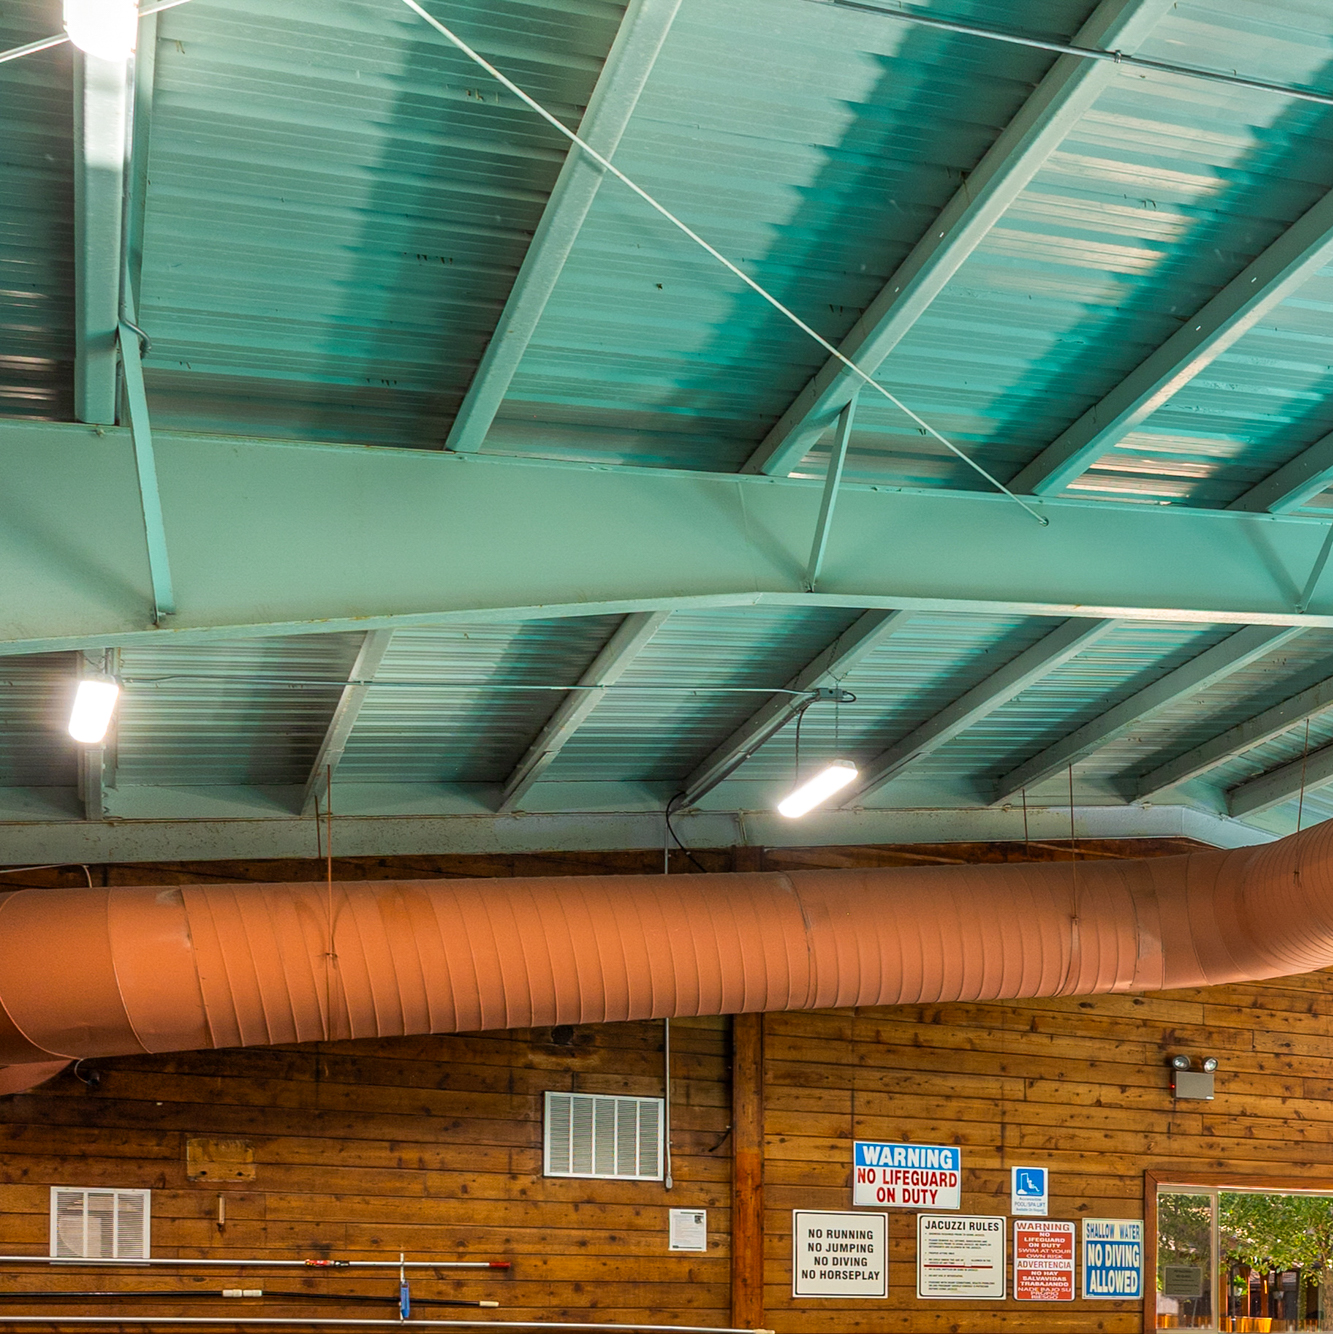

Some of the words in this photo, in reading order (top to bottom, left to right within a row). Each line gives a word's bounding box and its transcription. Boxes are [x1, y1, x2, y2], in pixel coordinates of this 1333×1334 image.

[862, 1145, 953, 1169] WARNING
[857, 1168, 876, 1184] NO
[882, 1169, 957, 1188] LIFEGUARD
[876, 1187, 895, 1203] ON
[902, 1188, 938, 1204] DUTY
[925, 1220, 966, 1231] JACUZZI
[969, 1222, 999, 1231] RULES
[1016, 1222, 1070, 1231] WARNING
[808, 1229, 822, 1239] NO
[826, 1229, 873, 1240] RUNNING
[1086, 1223, 1115, 1239] SHALLOW
[1119, 1224, 1140, 1240] WATER
[808, 1243, 822, 1252] NO
[826, 1243, 874, 1253] JUMPING
[1087, 1243, 1103, 1267] NO
[1105, 1244, 1140, 1268] DIVING
[814, 1256, 828, 1266] NO
[832, 1257, 867, 1267] DIVING
[1017, 1260, 1072, 1269] ADVERTENCIA
[801, 1270, 816, 1279] NO
[819, 1270, 880, 1280] HORSEPLAY
[1089, 1270, 1138, 1293] ALLOWED
